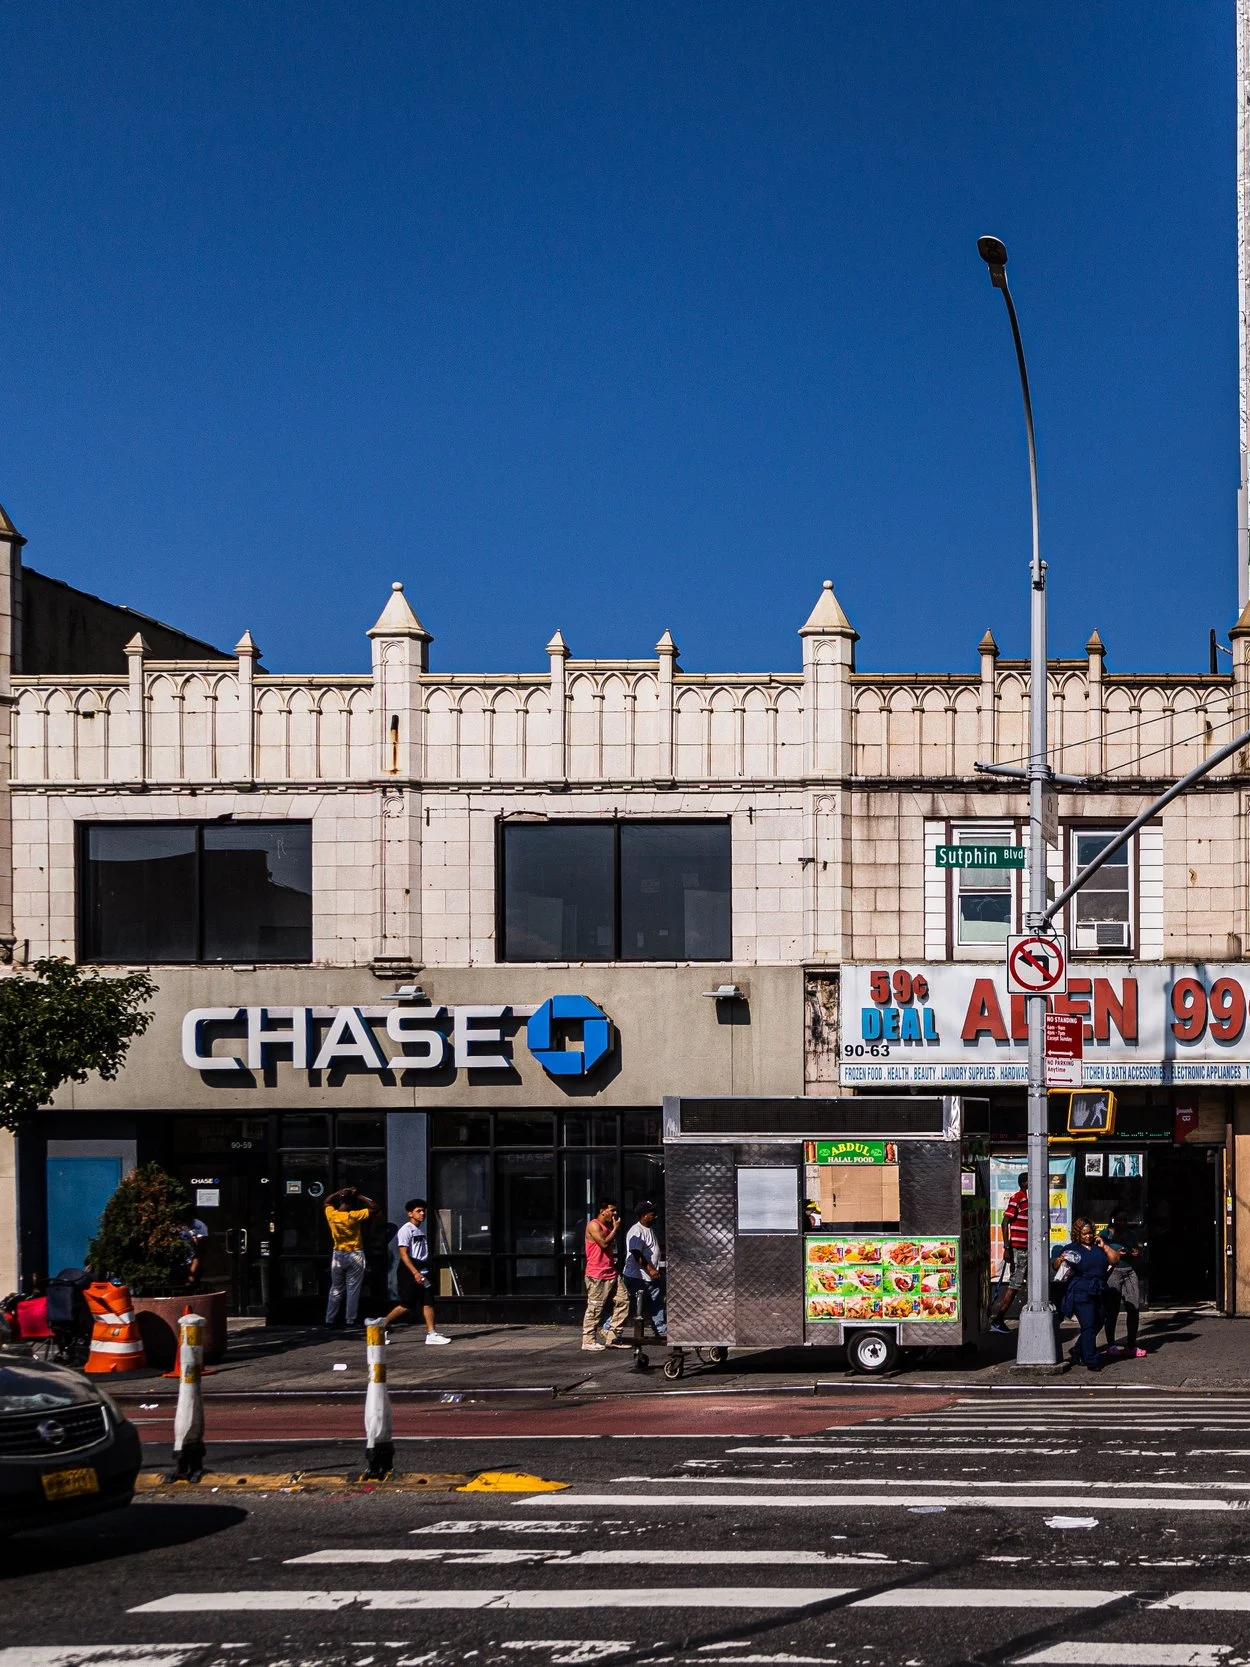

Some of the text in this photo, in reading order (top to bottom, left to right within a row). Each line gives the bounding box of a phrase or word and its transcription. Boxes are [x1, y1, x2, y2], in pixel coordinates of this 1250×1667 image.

[939, 848, 997, 868] Sutphin
[870, 969, 928, 1004] 59¢
[862, 1007, 940, 1041] DEAL
[182, 1007, 514, 1070] CHASE
[844, 1044, 890, 1058] 90-63
[845, 1067, 867, 1081] FROZEN
[868, 1067, 883, 1081] FOOD
[887, 1067, 909, 1081] HEALTH
[914, 1067, 936, 1081] BEAUTY
[941, 1066, 967, 1081] LAUNDRY
[968, 1066, 995, 1081] SUPPLIES
[1000, 1066, 1029, 1081] HARDWAR
[1084, 1066, 1105, 1080] ITCHEN
[1106, 1066, 1111, 1080] &
[1112, 1066, 1127, 1080] BATH
[1128, 1066, 1166, 1080] ACCESSORIES
[1171, 1066, 1205, 1080] ELECTRONIC
[1206, 1066, 1241, 1080] APPLIANCES
[831, 1142, 870, 1157] ABDUL
